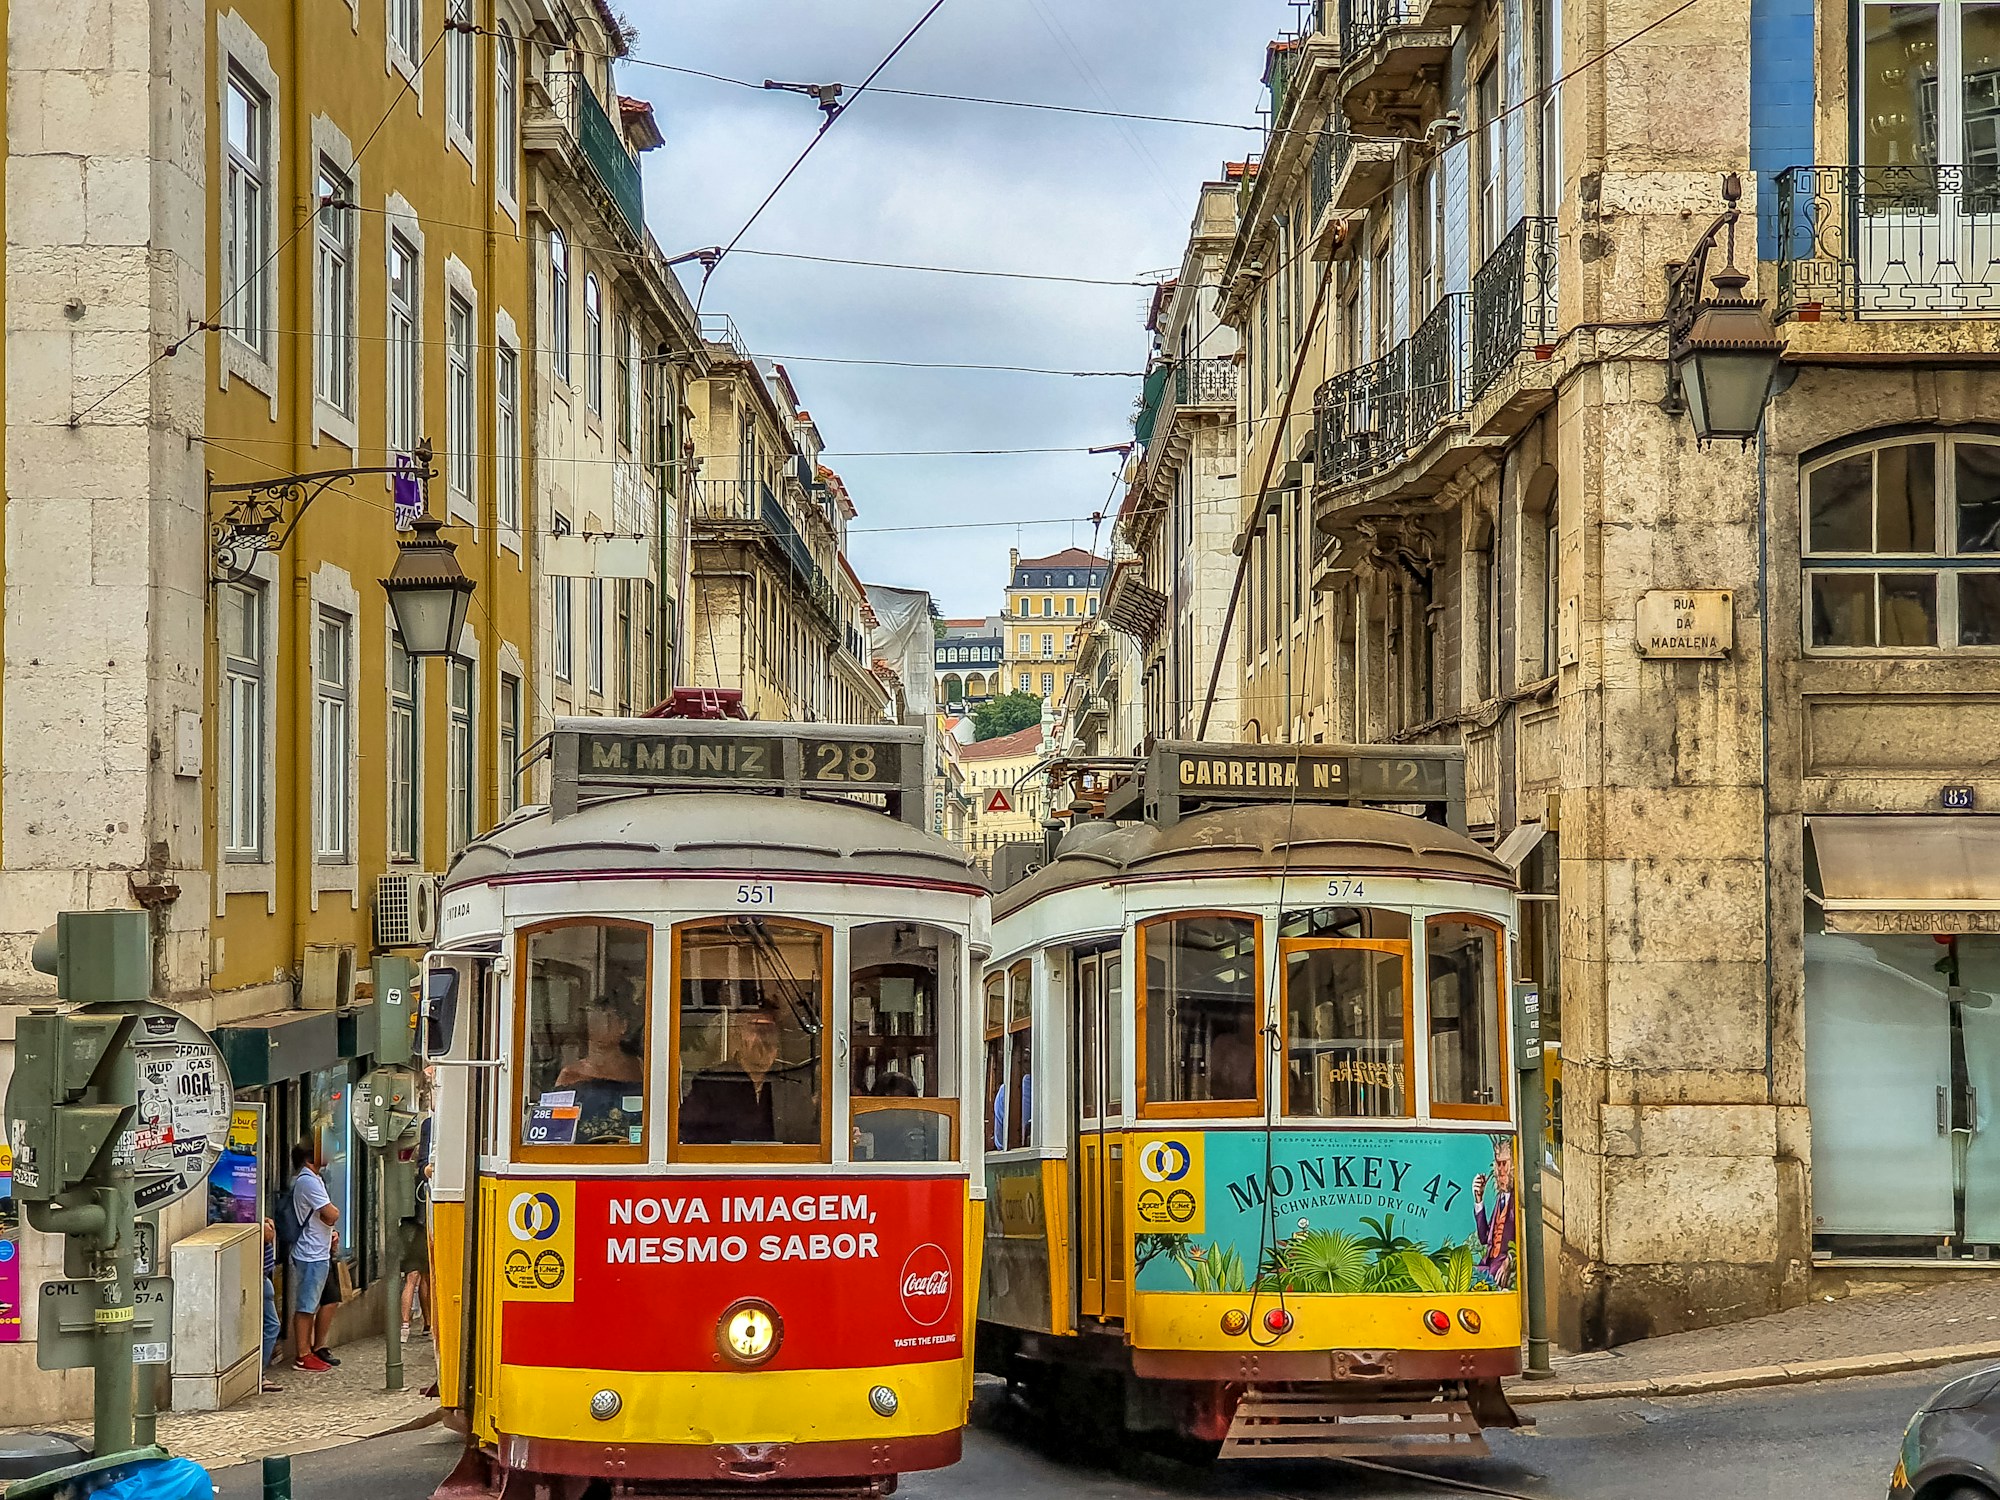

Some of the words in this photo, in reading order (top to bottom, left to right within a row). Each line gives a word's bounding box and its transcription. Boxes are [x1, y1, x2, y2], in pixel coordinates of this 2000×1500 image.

[1673, 599, 1696, 610] RUA
[1676, 618, 1693, 630] DA
[1651, 636, 1718, 649] MADALENA
[816, 742, 877, 782] 28
[1179, 759, 1299, 787] CARREIRA
[1377, 760, 1419, 790] 12
[1948, 789, 1969, 805] 83
[736, 885, 774, 904] 551
[1327, 880, 1365, 897] 574
[1876, 914, 1893, 932] LA
[1900, 913, 1963, 932] FABBRICA
[532, 1109, 552, 1119] 28E
[529, 1126, 548, 1139] 09
[1226, 1155, 1412, 1213] MONKEY
[1422, 1174, 1462, 1212] 47
[608, 1197, 710, 1225] NOVA
[721, 1194, 878, 1225] IMAGEM,
[1272, 1193, 1372, 1217] SCHWARZWALD
[1377, 1193, 1402, 1211] DRY
[1406, 1202, 1428, 1219] GIN
[606, 1236, 748, 1264] MESMO
[758, 1232, 880, 1262] SABOR
[44, 1284, 79, 1297] CML
[135, 1293, 164, 1304] 57-A
[894, 1338, 917, 1348] TASTE
[918, 1336, 931, 1346] THE
[932, 1334, 956, 1344] FEELING
